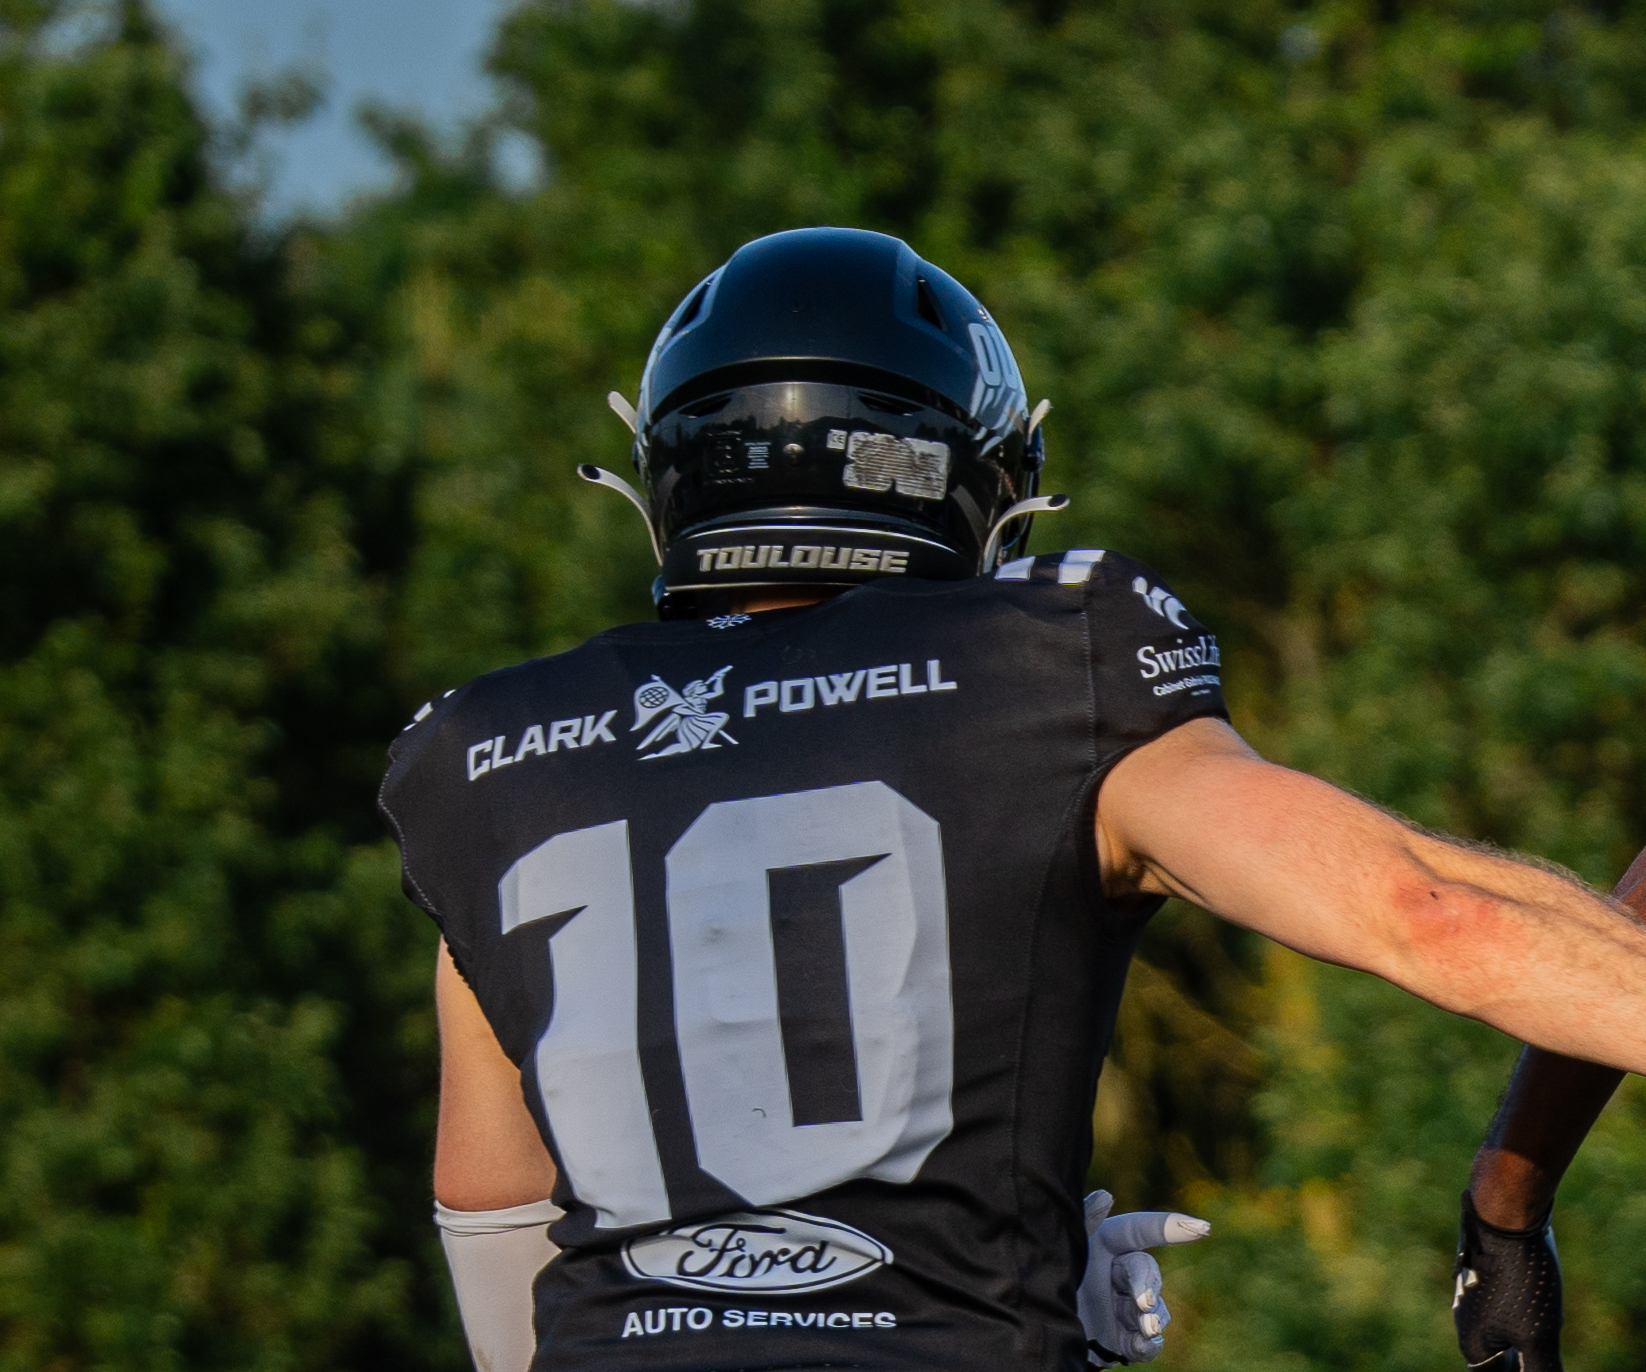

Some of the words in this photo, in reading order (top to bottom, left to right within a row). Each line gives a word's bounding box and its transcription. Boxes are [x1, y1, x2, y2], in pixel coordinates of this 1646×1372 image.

[697, 545, 910, 573] TOULOUSE
[467, 710, 617, 781] CLARK
[744, 659, 957, 718] POWELL
[498, 781, 953, 1229] 10
[676, 1223, 837, 1279] Ford
[621, 1307, 713, 1338] AUTO
[722, 1309, 897, 1328] SERVICES
